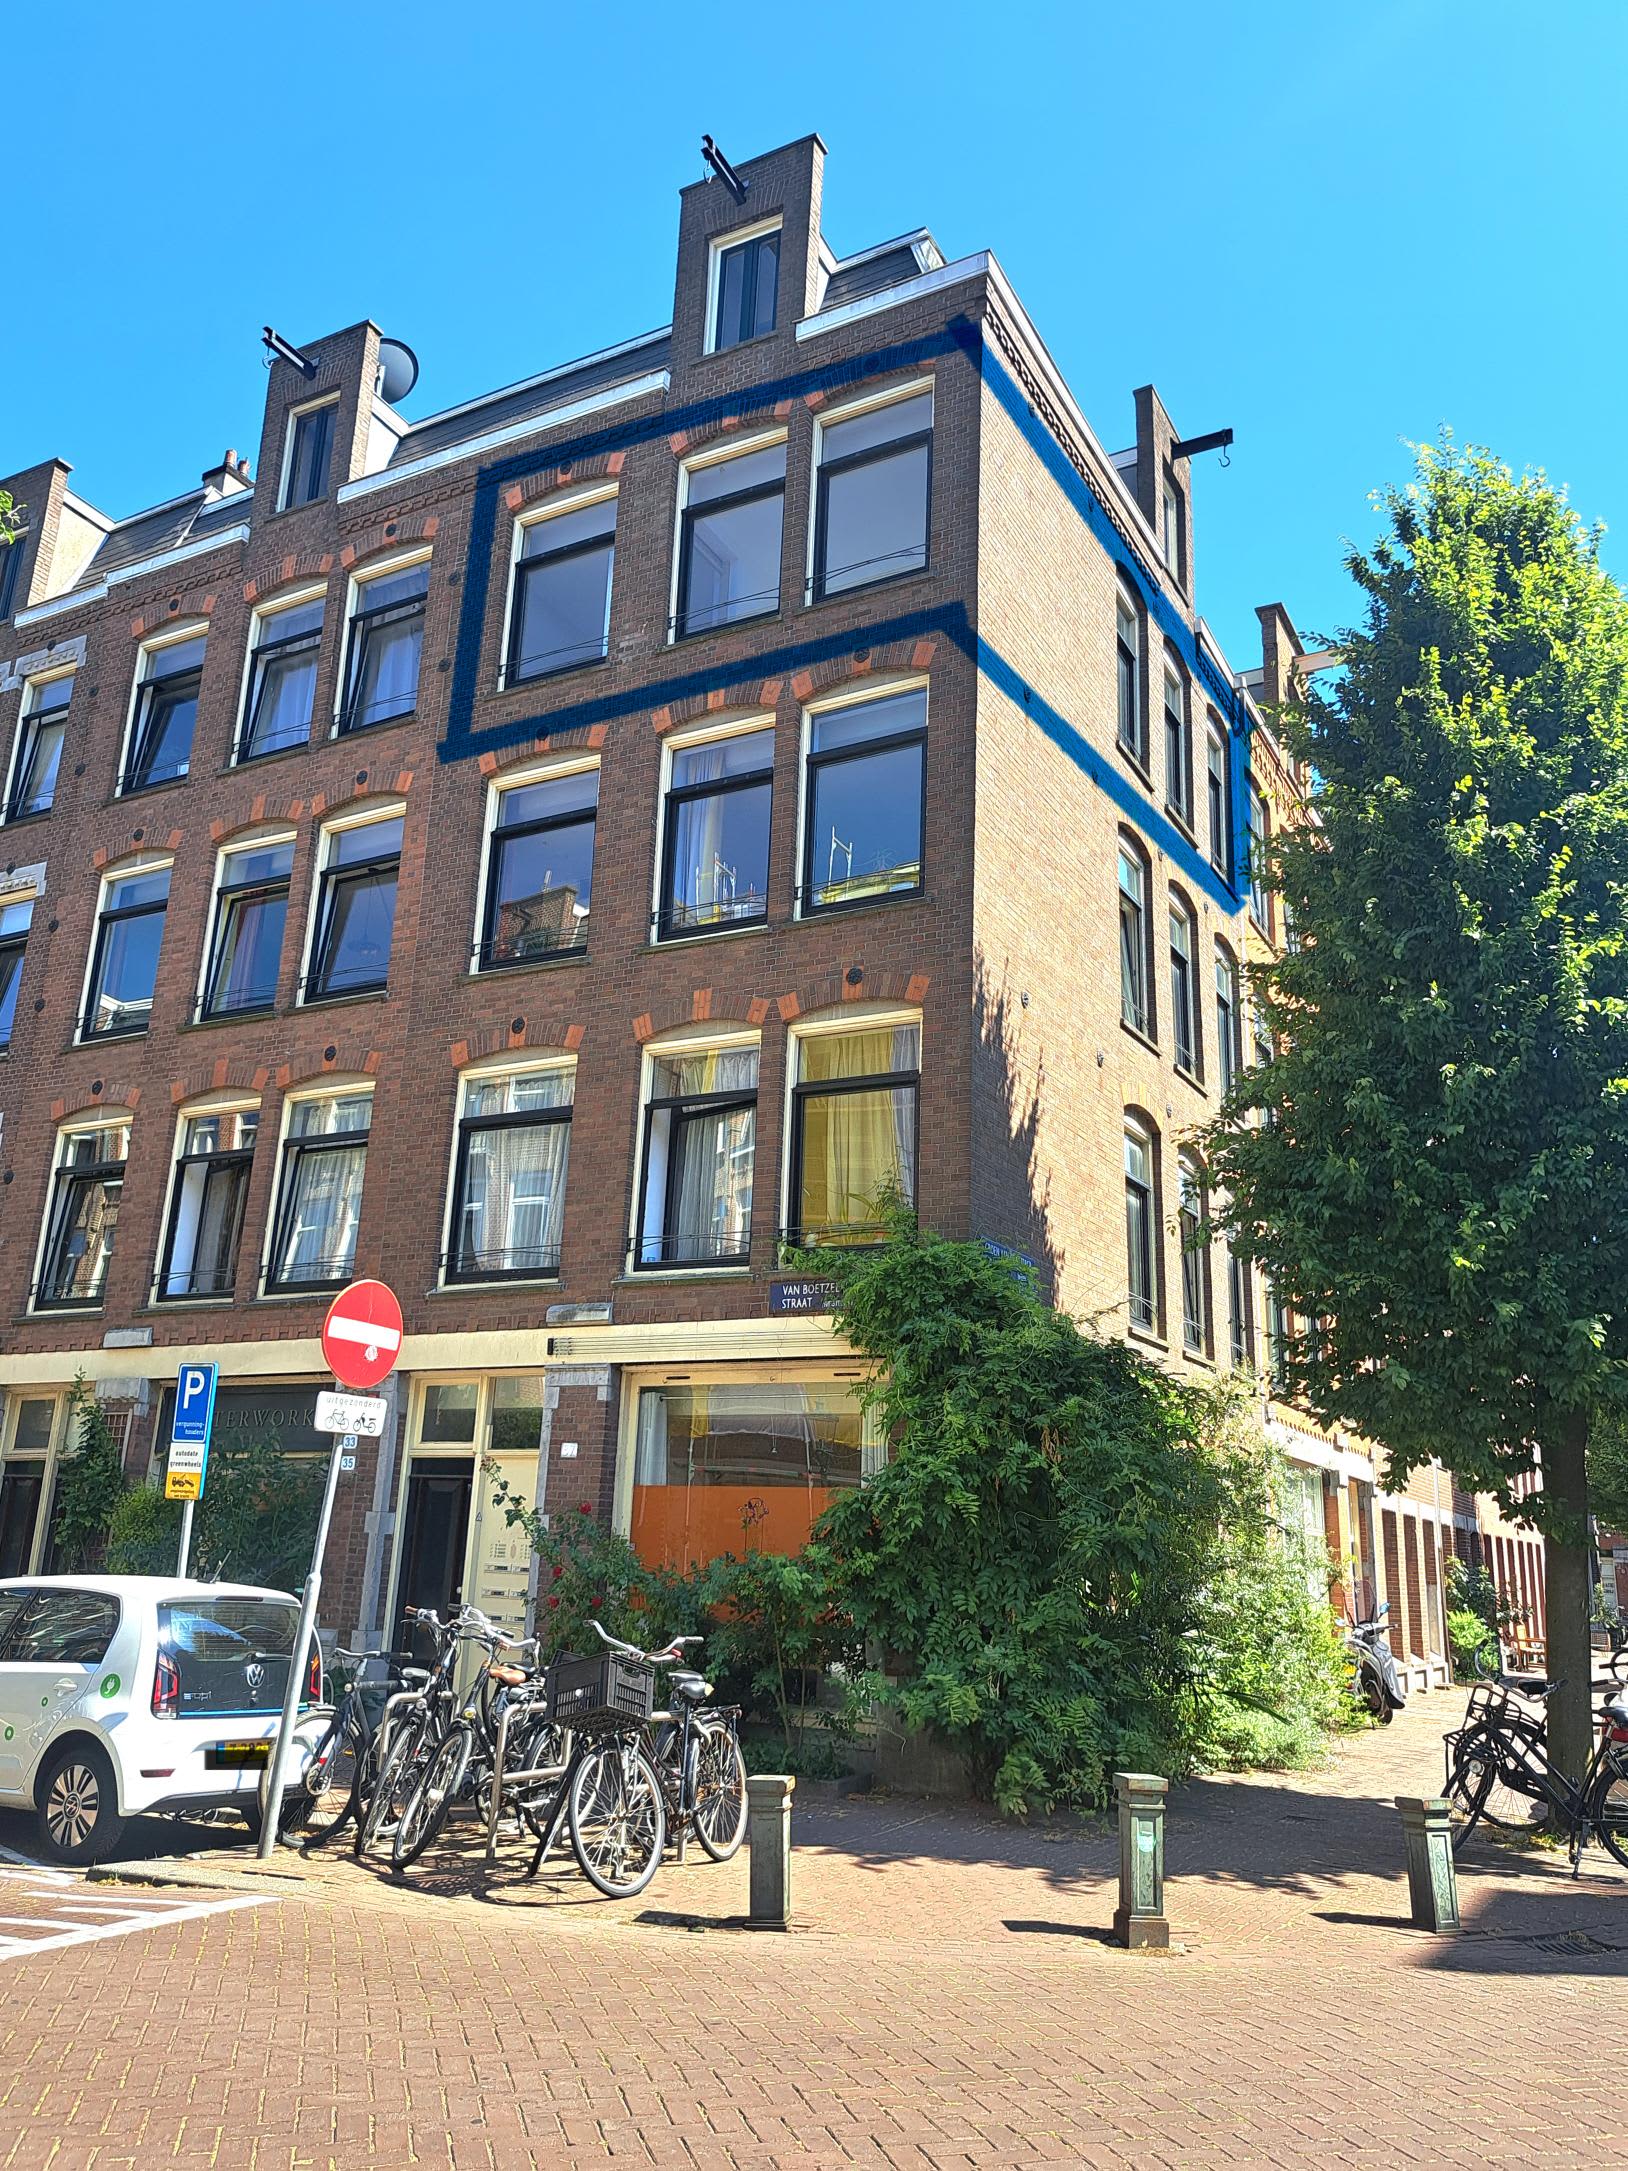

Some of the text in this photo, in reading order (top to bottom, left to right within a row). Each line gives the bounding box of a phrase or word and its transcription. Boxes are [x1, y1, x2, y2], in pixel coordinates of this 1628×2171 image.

[782, 1282, 840, 1296] VAN BOETZEL
[781, 1297, 813, 1309] STRAAT
[183, 1370, 205, 1409] P
[326, 1396, 382, 1409] uitgezonderd
[344, 1436, 356, 1448] 33
[342, 1457, 354, 1469] 35
